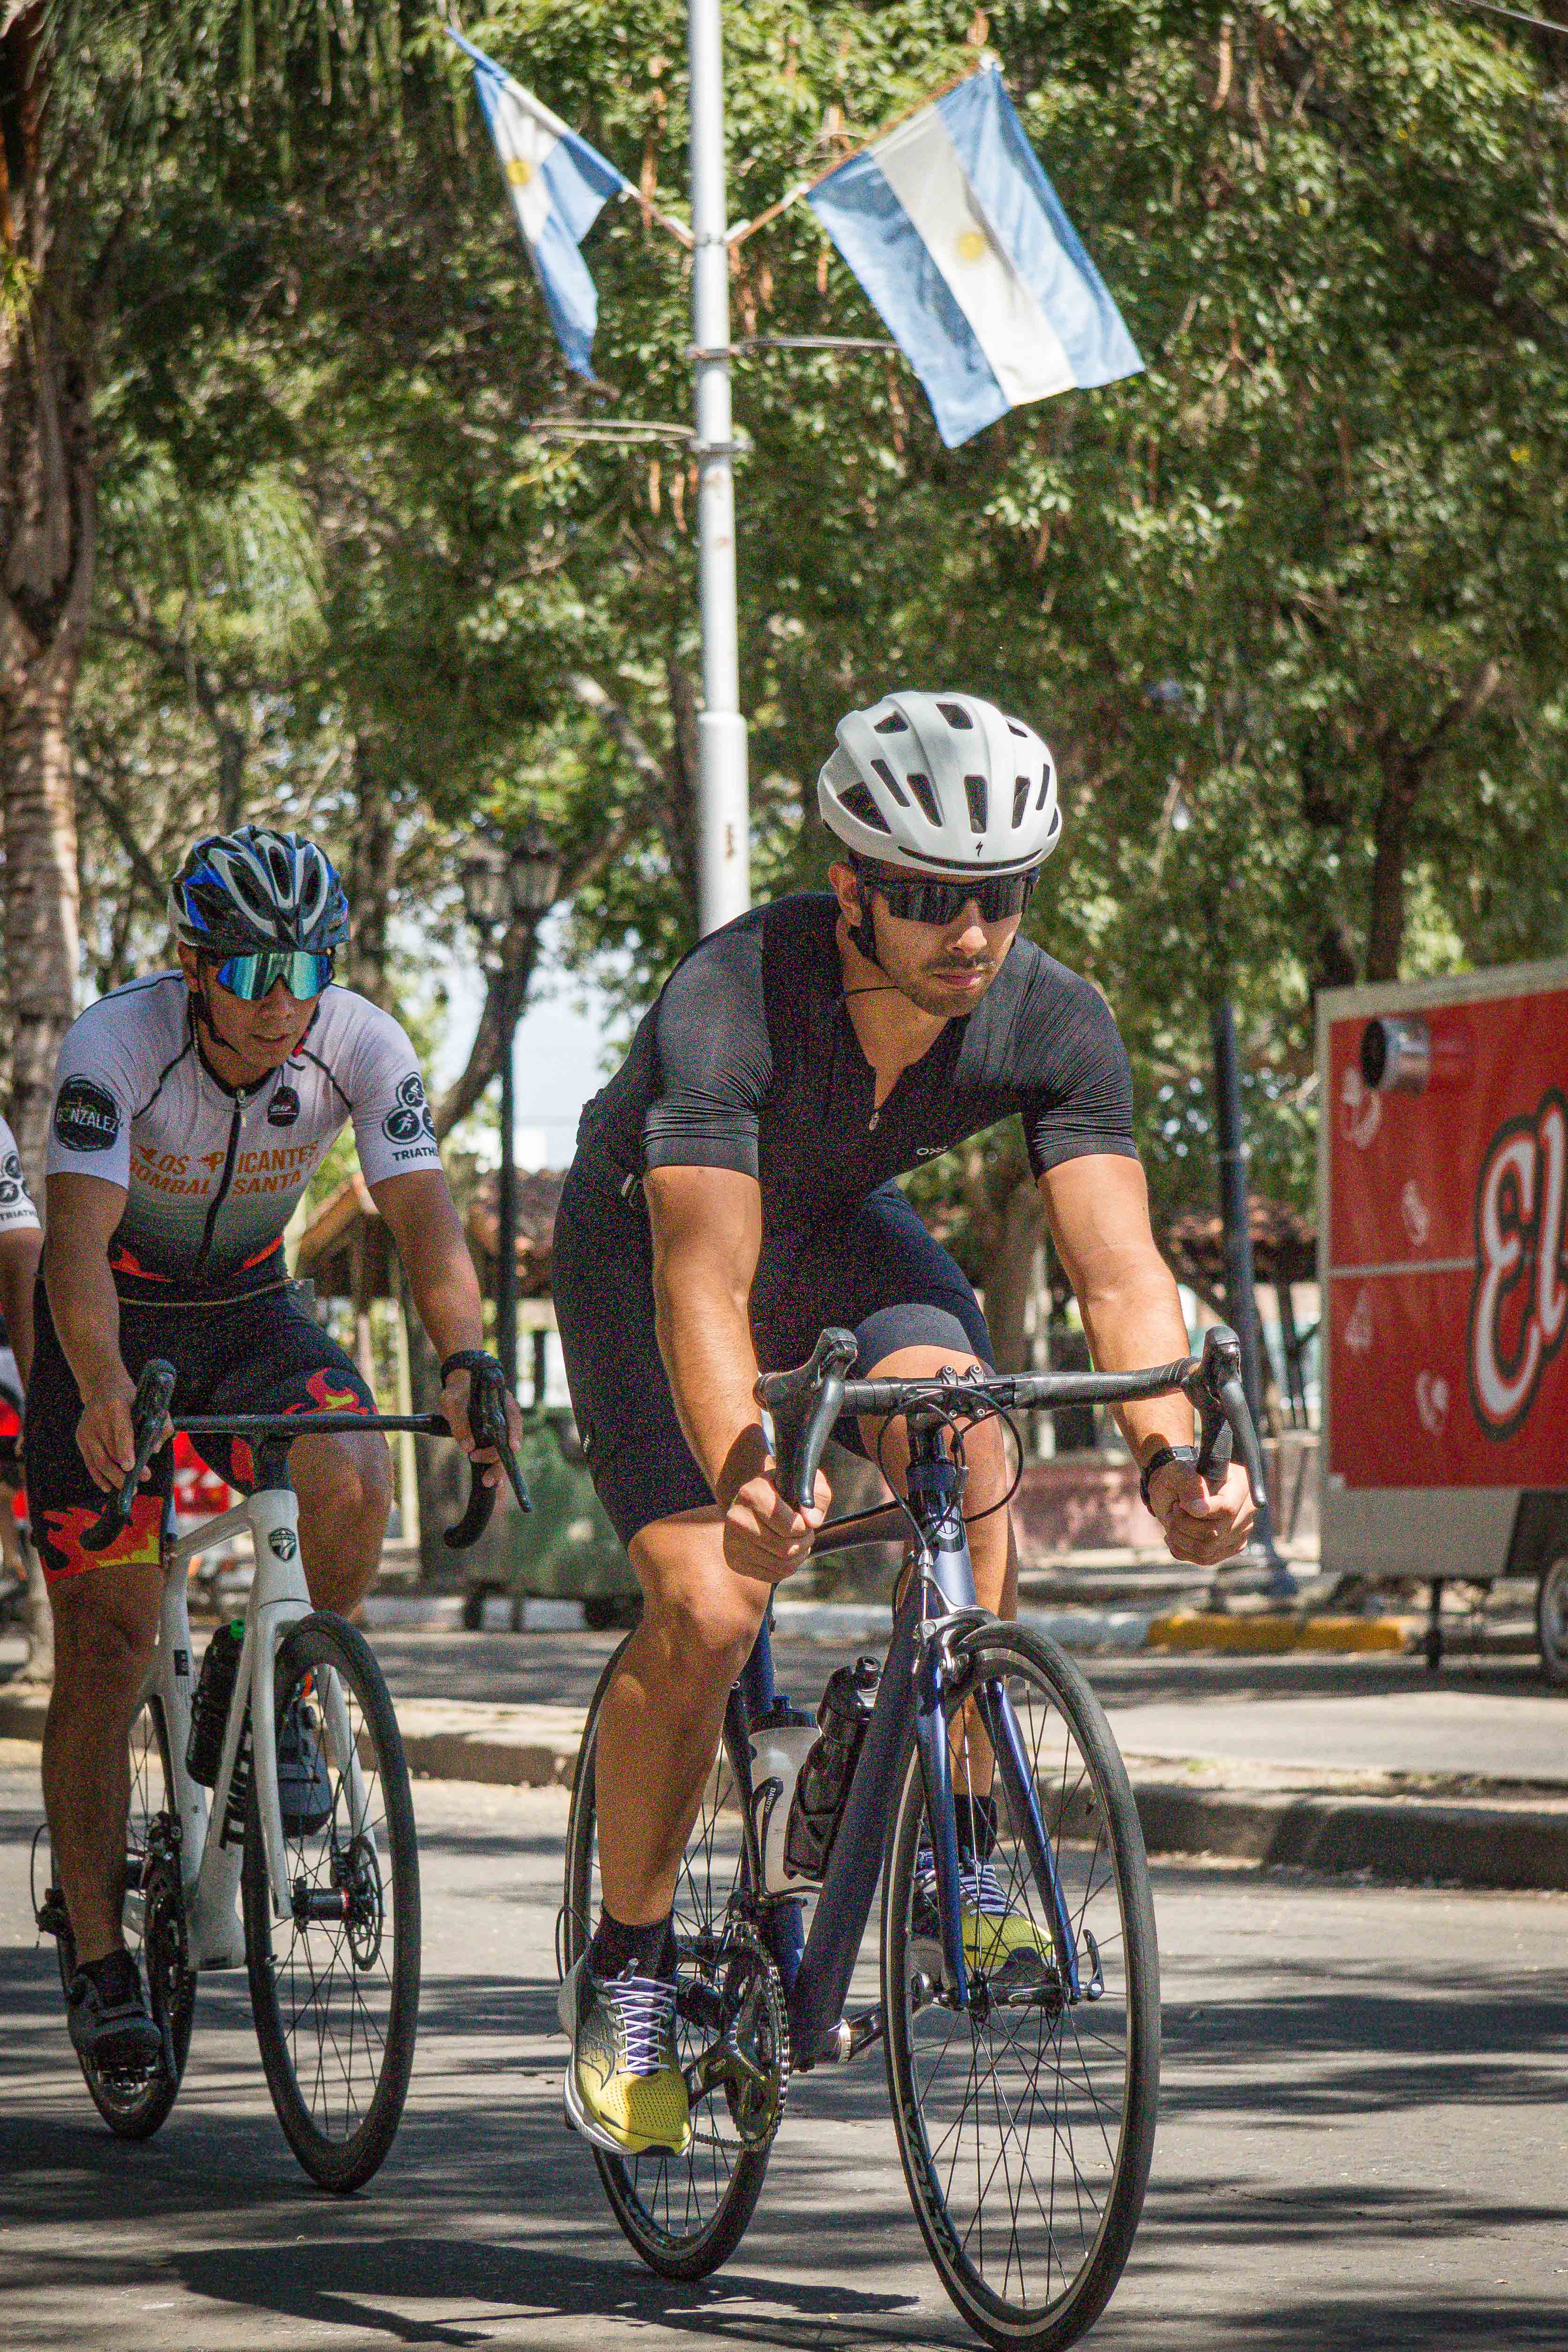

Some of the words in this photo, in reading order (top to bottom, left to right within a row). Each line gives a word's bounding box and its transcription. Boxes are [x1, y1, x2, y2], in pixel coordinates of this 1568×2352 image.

[136, 1145, 190, 1175] LOS
[232, 1170, 301, 1195] SANTA
[765, 1787, 776, 1813] DAKOTA
